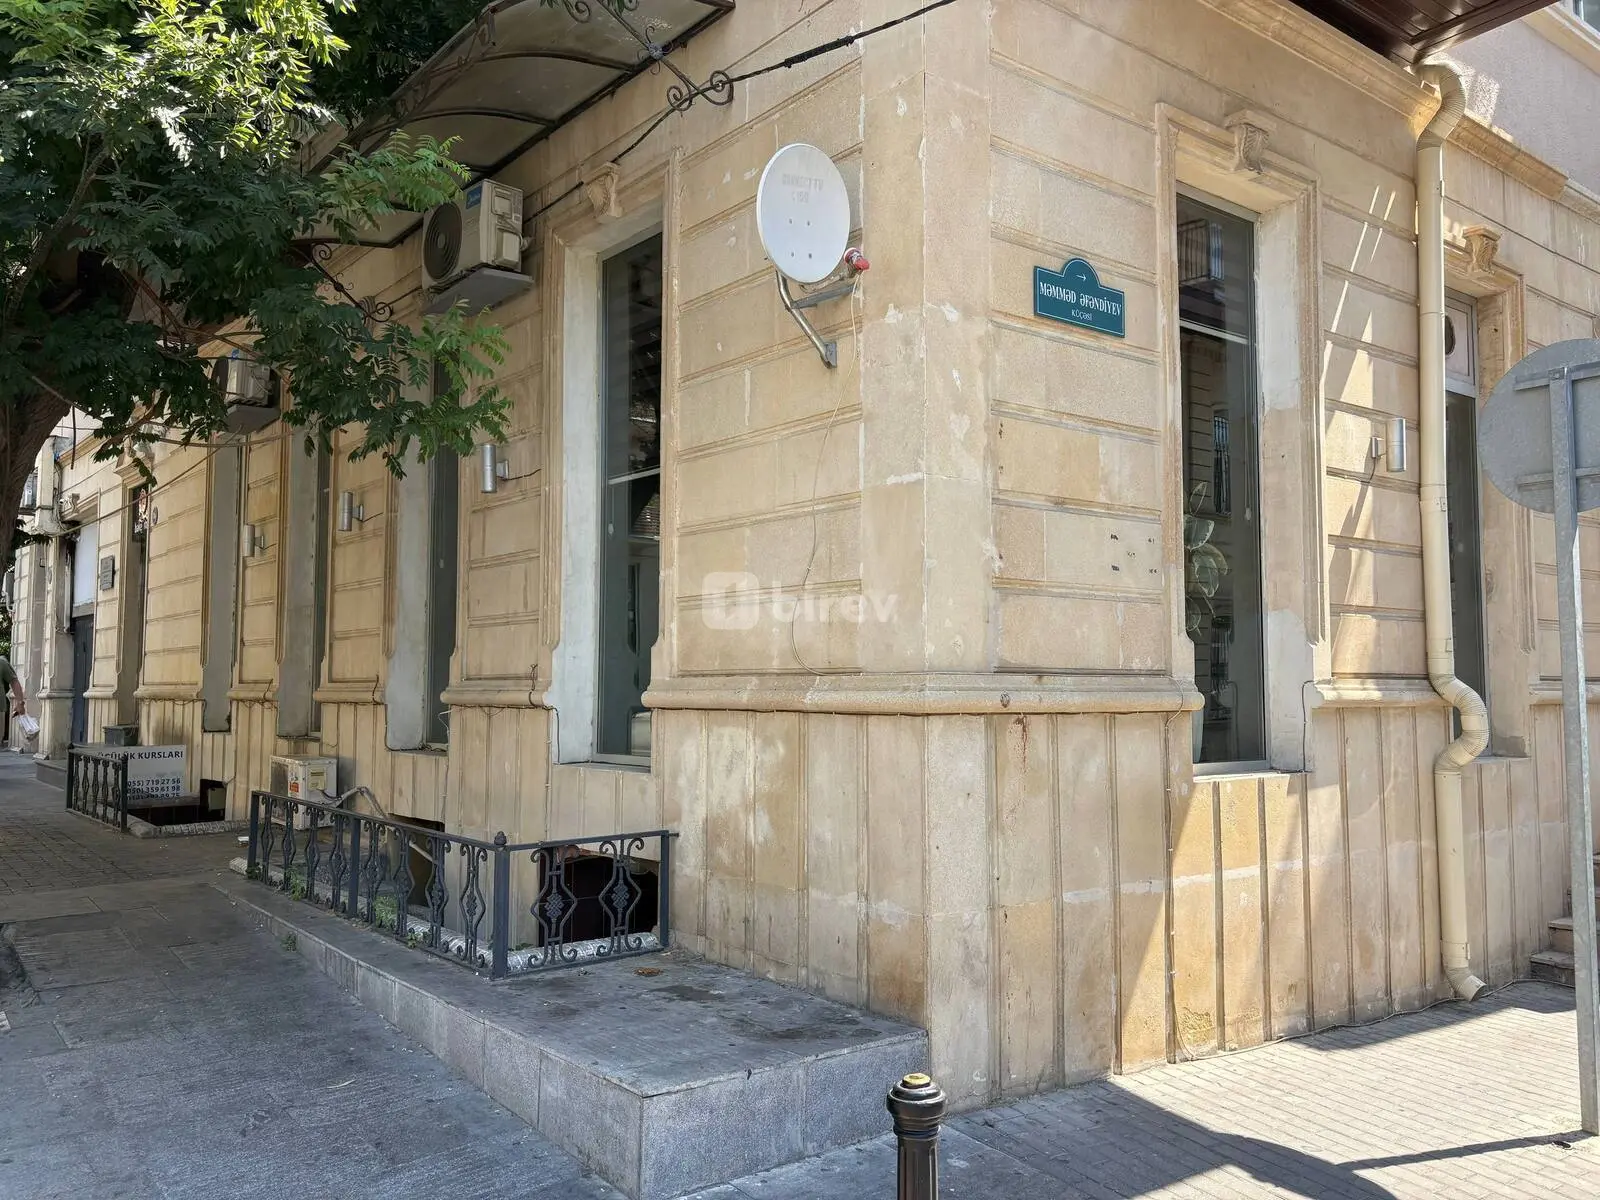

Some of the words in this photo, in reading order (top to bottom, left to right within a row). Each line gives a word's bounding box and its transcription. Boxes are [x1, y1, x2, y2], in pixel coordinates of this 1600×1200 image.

[1039, 282, 1076, 303] MƏMMƏD
[1079, 293, 1121, 316] ƏFƏNDİYEV
[138, 751, 183, 760] KURSLARI
